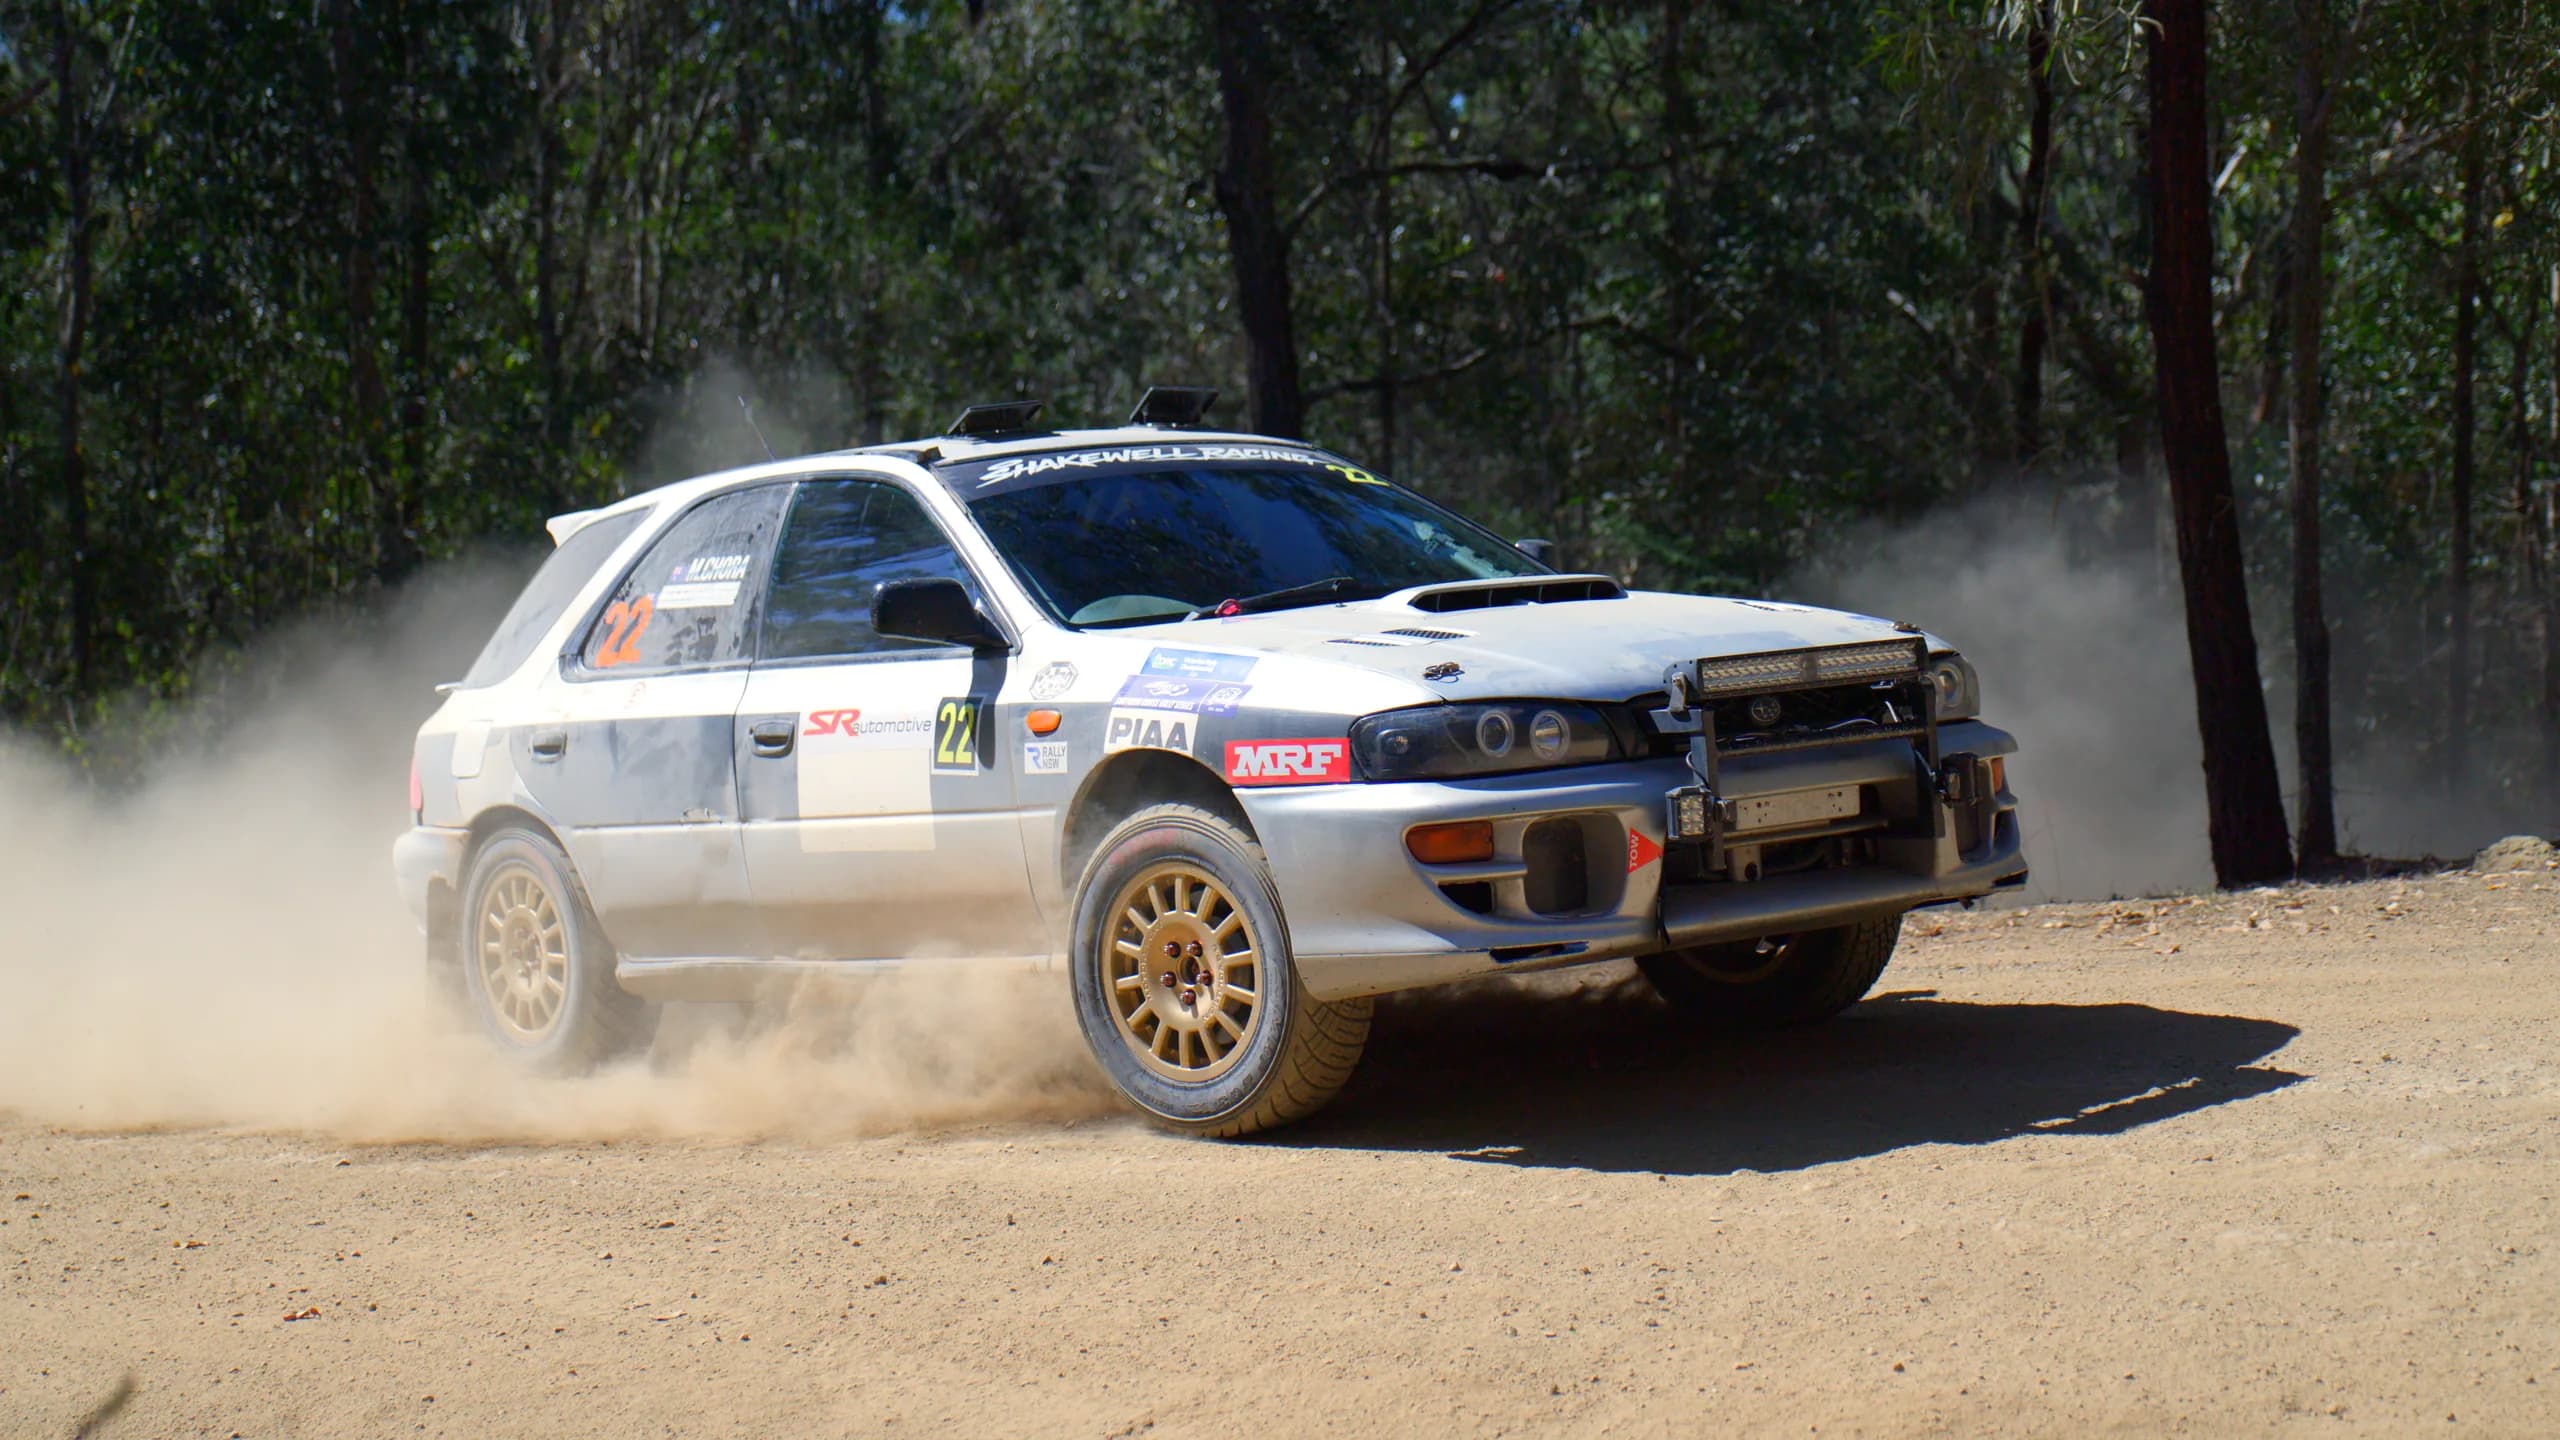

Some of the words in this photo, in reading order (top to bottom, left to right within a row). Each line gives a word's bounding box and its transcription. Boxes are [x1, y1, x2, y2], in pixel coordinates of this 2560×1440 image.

[976, 447, 1199, 488] SHAKEWELL
[1198, 447, 1318, 466] RACING
[596, 595, 654, 667] 22
[802, 708, 862, 737] SR
[852, 716, 932, 736] automotive
[938, 702, 974, 764] 22
[1109, 717, 1188, 751] PIAA
[1042, 745, 1066, 757] RALLY
[1042, 757, 1060, 769] NSW
[1232, 744, 1341, 776] MRF
[1629, 834, 1639, 869] TOW
